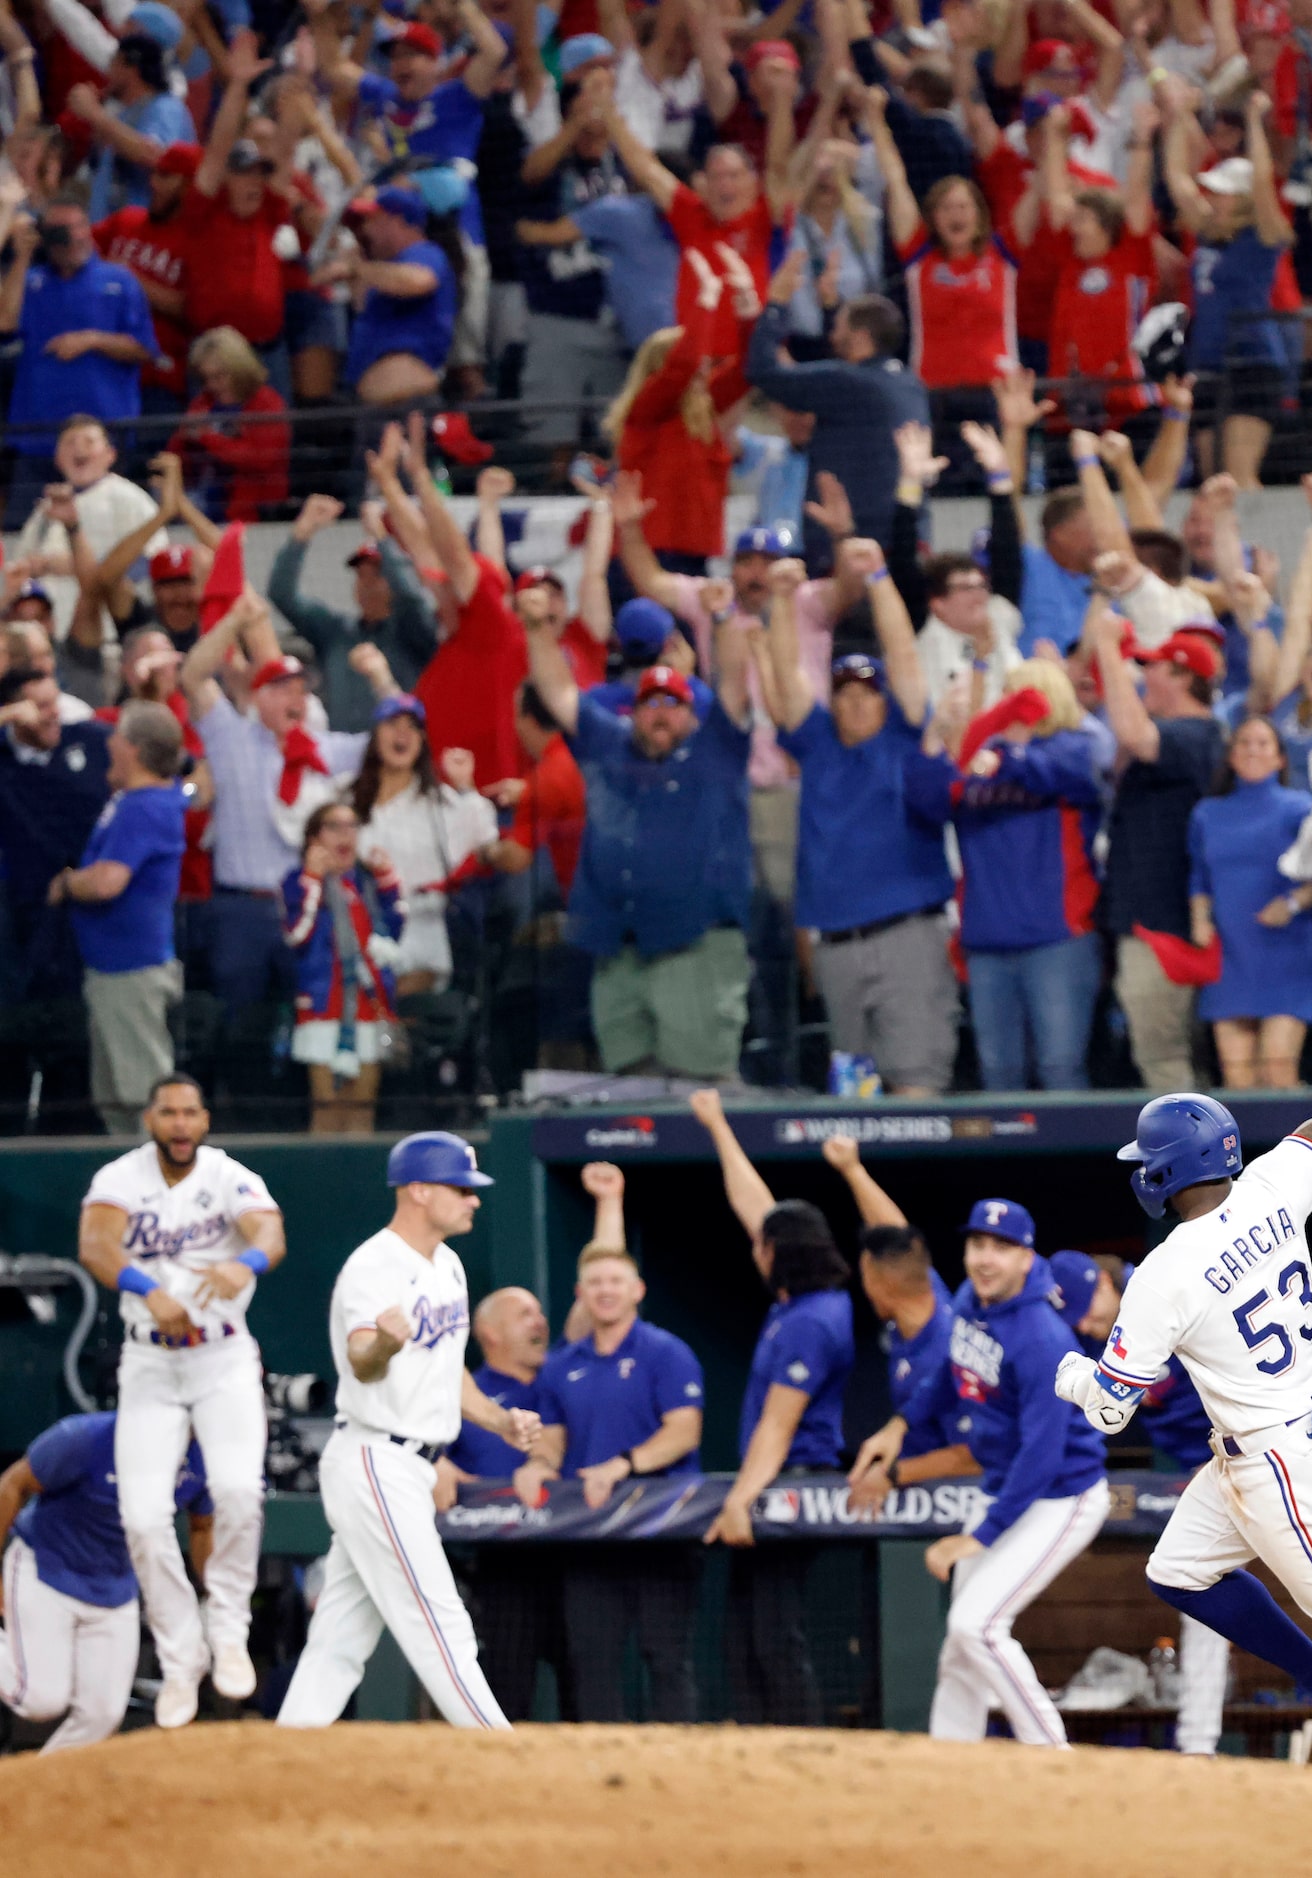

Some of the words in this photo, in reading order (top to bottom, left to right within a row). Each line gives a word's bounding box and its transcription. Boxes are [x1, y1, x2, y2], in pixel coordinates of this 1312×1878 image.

[881, 1116, 952, 1142] SERIES
[984, 1201, 1008, 1226] T
[1204, 1207, 1297, 1295] GARCIA
[1110, 1382, 1131, 1397] 53
[802, 1486, 933, 1525] WOLD
